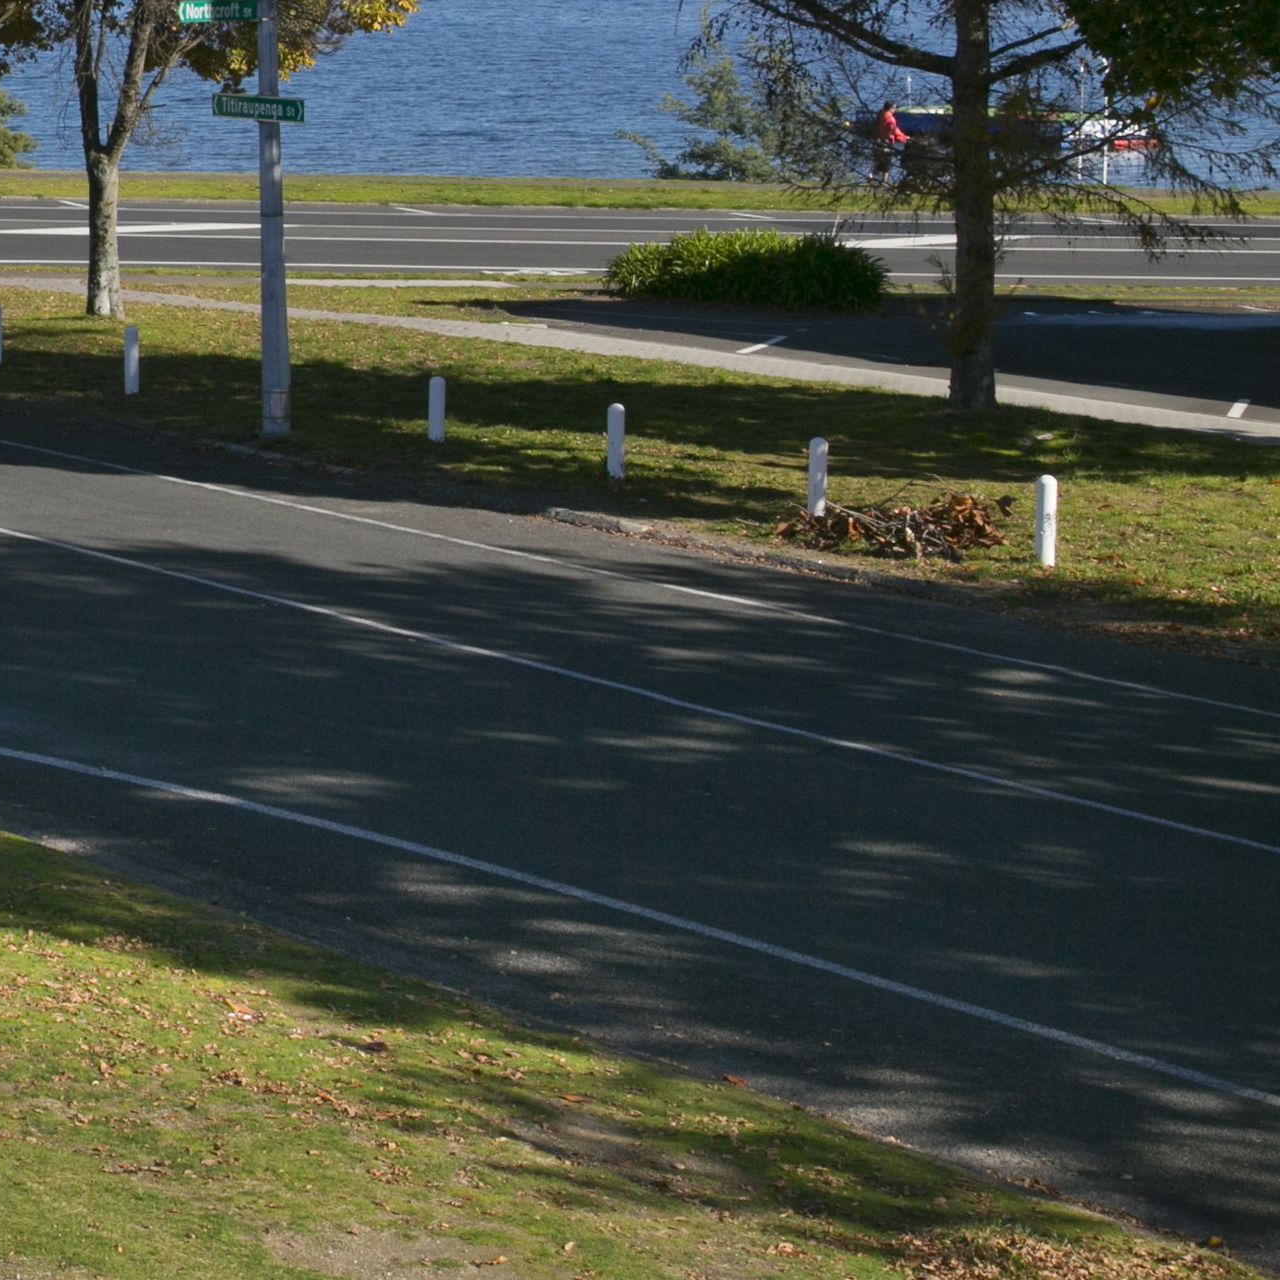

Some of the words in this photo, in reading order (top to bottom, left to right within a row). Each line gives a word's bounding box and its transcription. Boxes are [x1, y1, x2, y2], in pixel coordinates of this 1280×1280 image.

[186, 2, 240, 19] Northcroft
[243, 7, 253, 17] St
[221, 97, 284, 120] Titiraupenga
[286, 105, 296, 117] St
